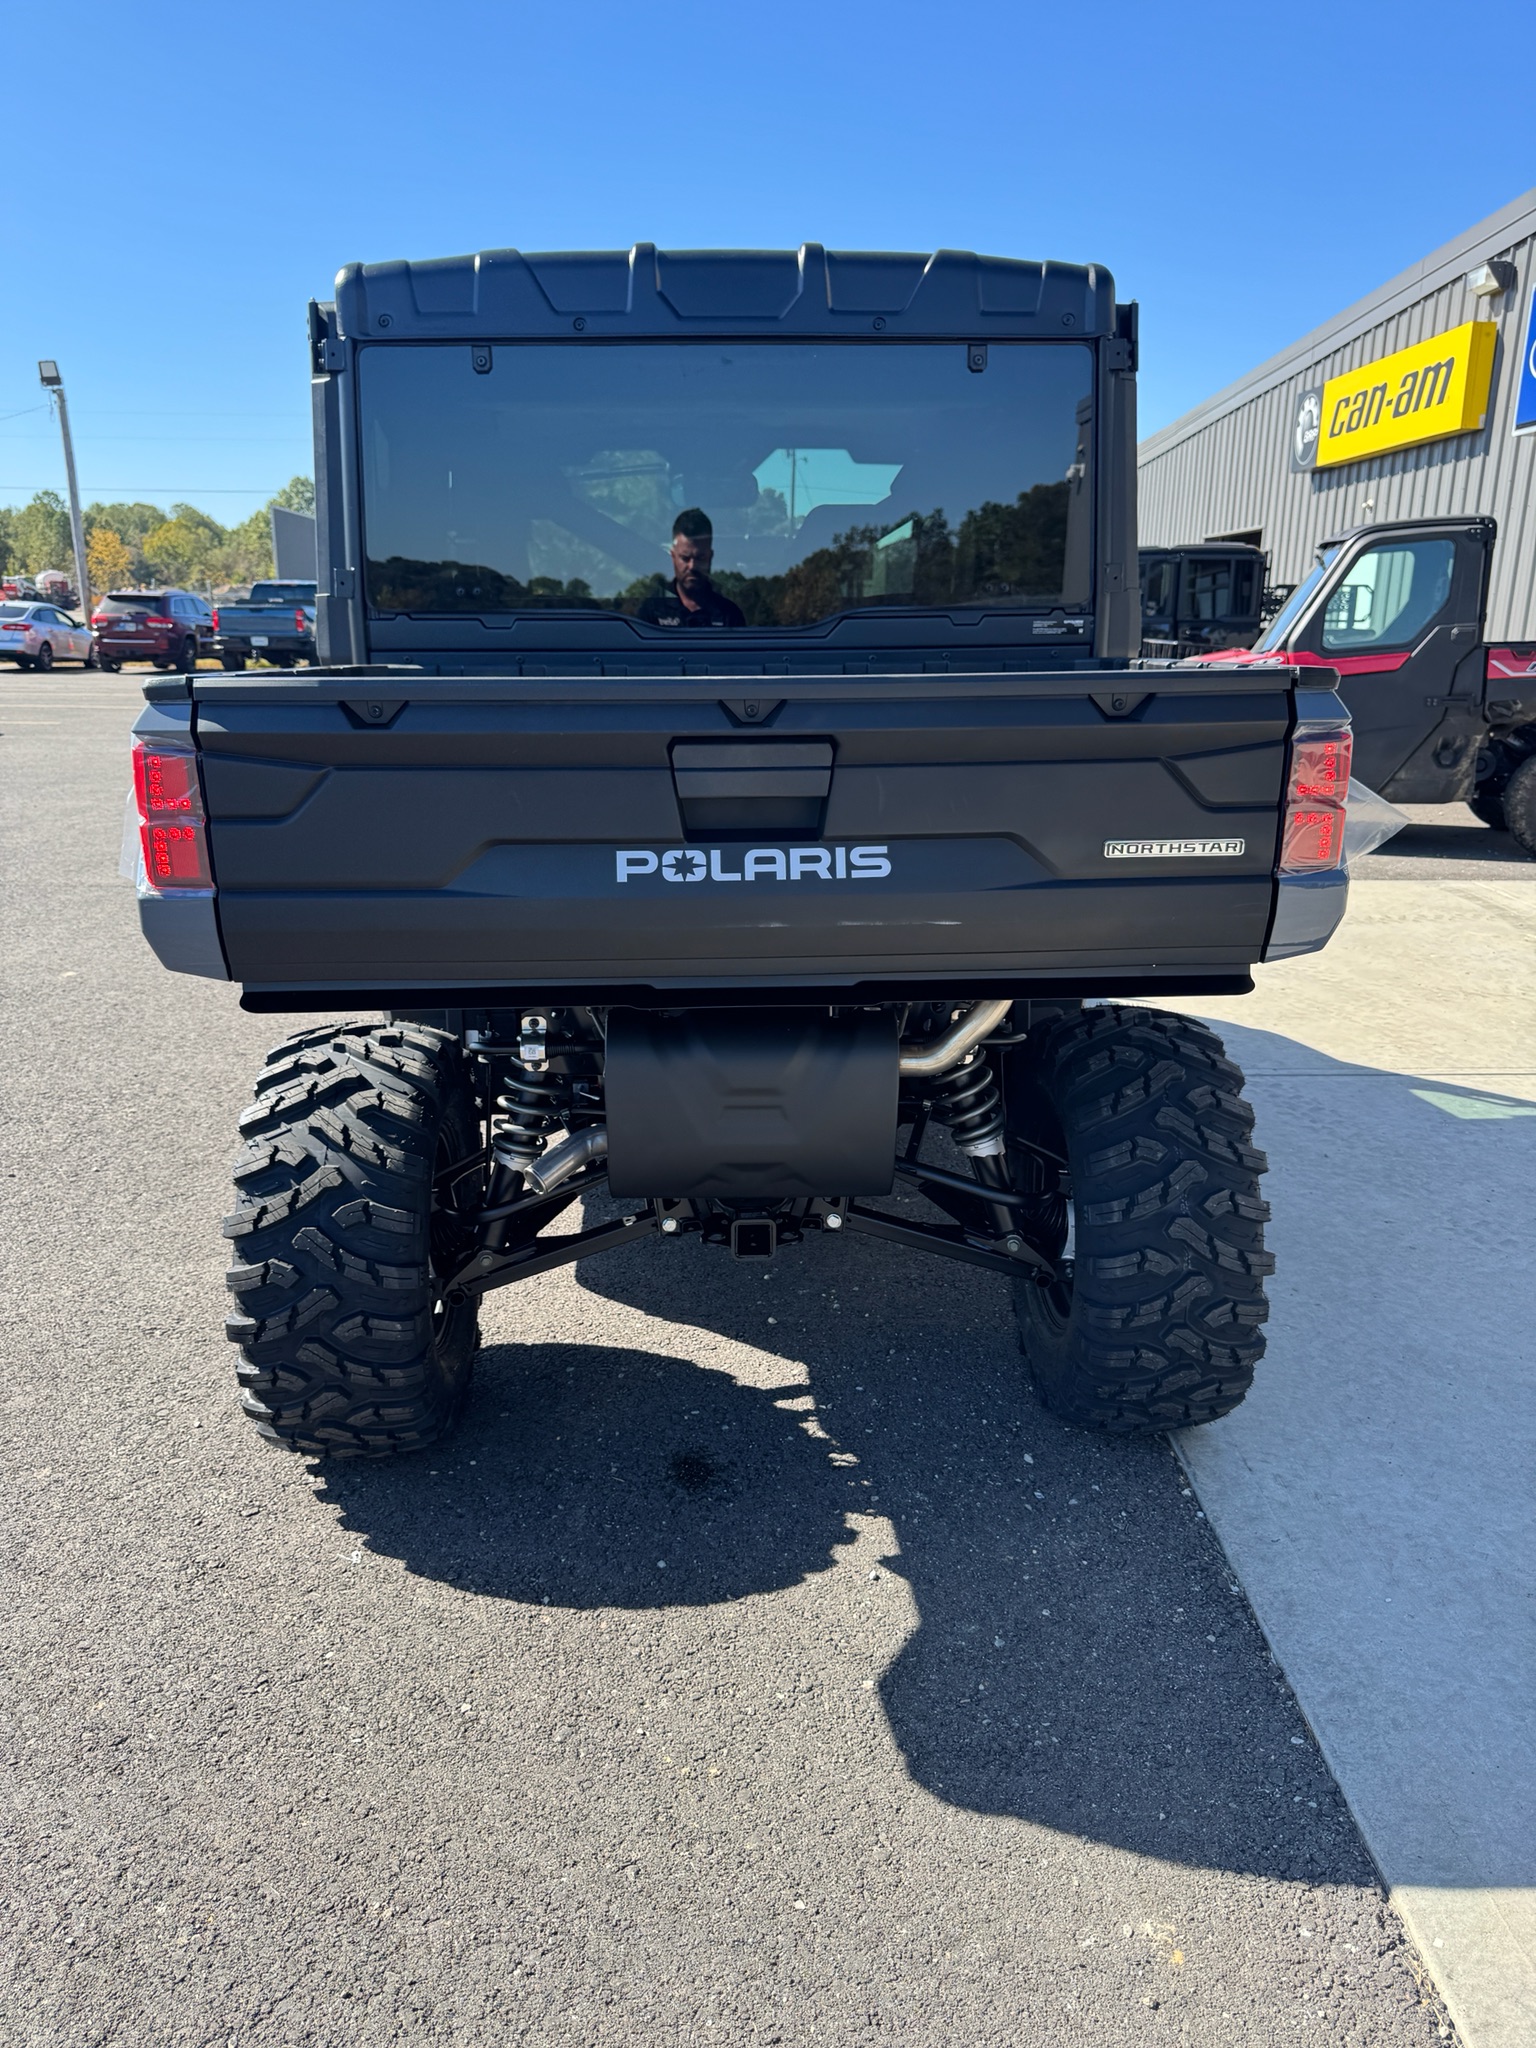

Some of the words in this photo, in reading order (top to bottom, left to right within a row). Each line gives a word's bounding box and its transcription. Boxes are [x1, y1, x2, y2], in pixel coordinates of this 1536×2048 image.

[1329, 356, 1455, 438] can-am
[616, 845, 892, 883] POLARIS
[1110, 841, 1239, 855] NORTHSTAR
